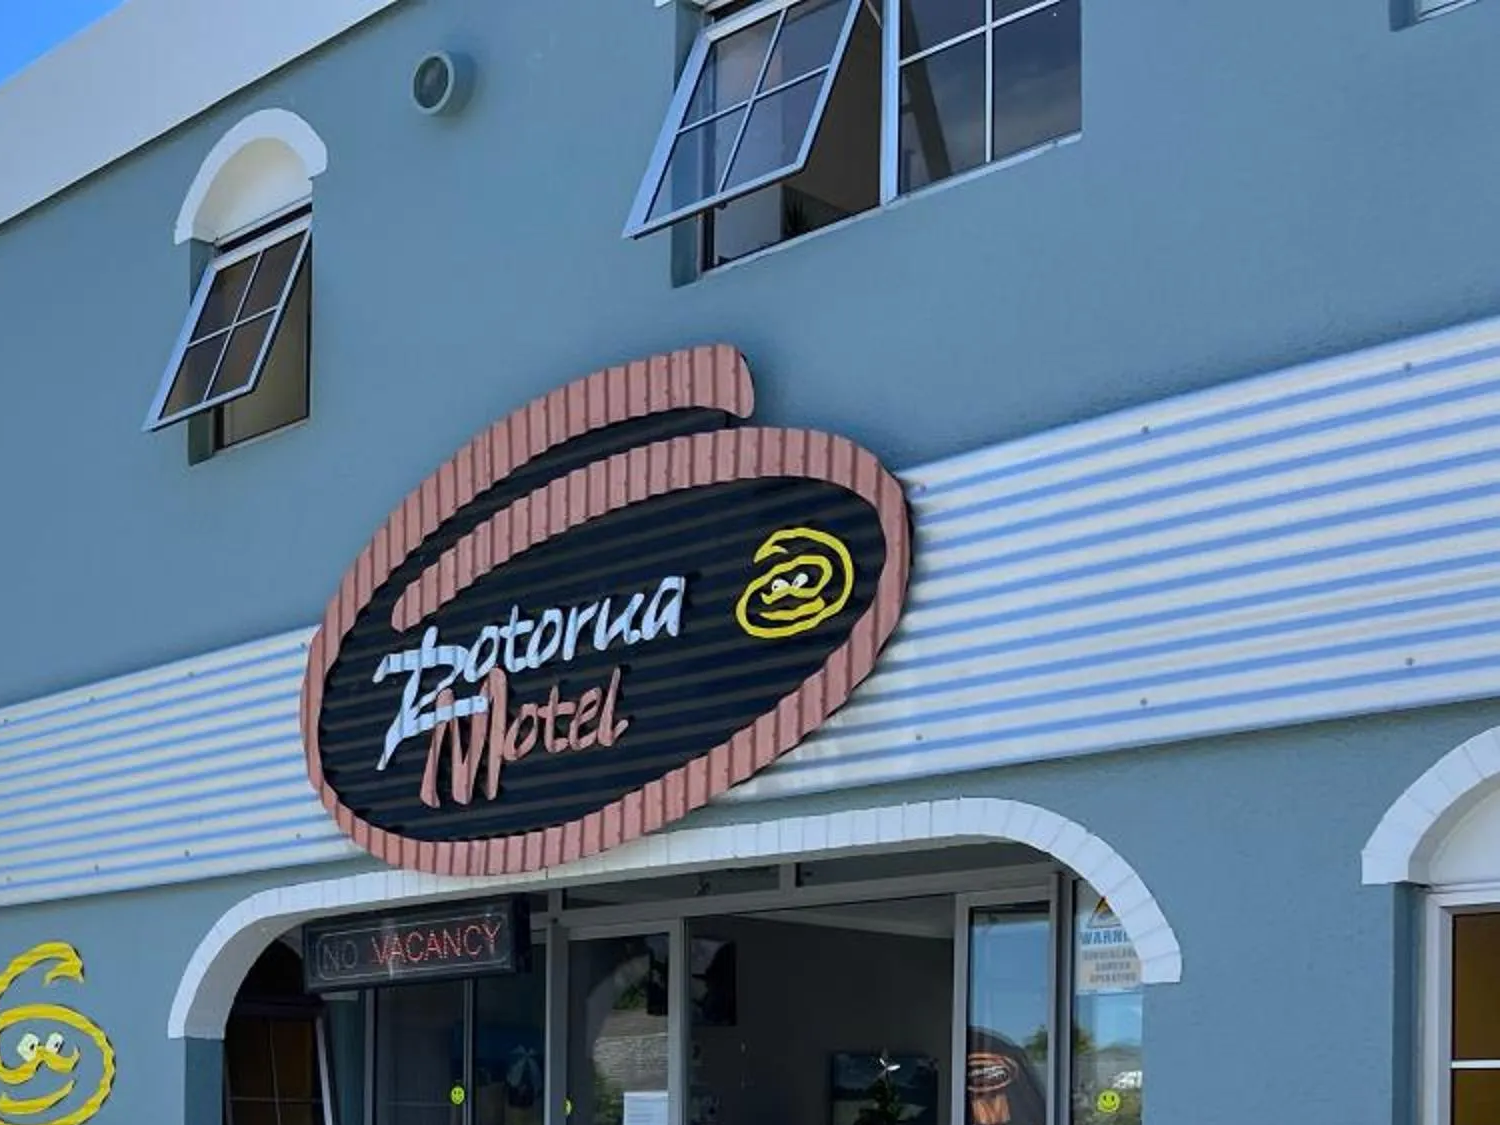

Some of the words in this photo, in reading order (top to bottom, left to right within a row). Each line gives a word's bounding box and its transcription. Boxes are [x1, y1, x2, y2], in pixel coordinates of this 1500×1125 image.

[372, 575, 687, 772] Rotorua
[419, 663, 630, 808] Motel
[323, 940, 359, 973] NO
[371, 922, 501, 965] VACANCY
